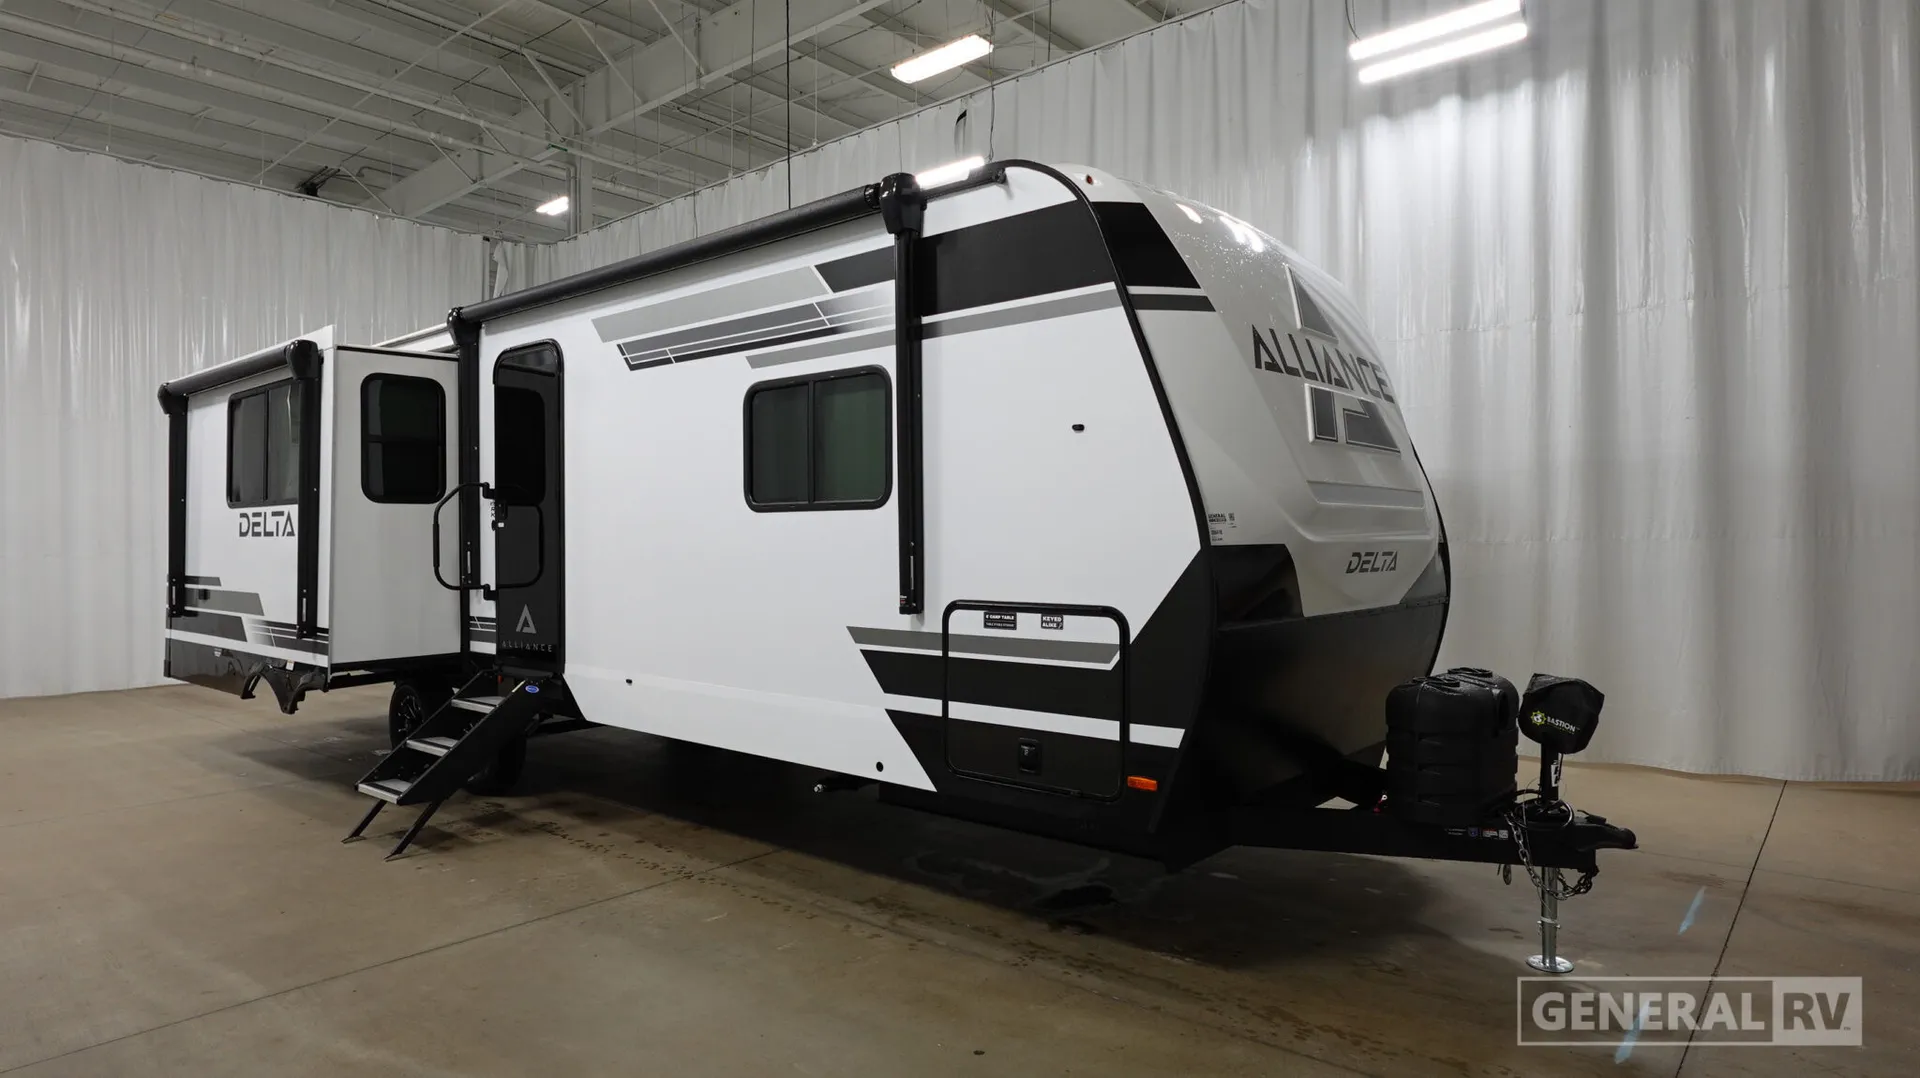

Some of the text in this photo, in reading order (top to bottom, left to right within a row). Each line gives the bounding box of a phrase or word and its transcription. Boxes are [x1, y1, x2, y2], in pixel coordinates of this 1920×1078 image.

[1252, 324, 1396, 404] ALLIANCE
[239, 510, 296, 537] DELTA
[1345, 551, 1398, 574] DELTA
[502, 640, 552, 652] ALLIANCE
[1547, 716, 1576, 732] BASTION
